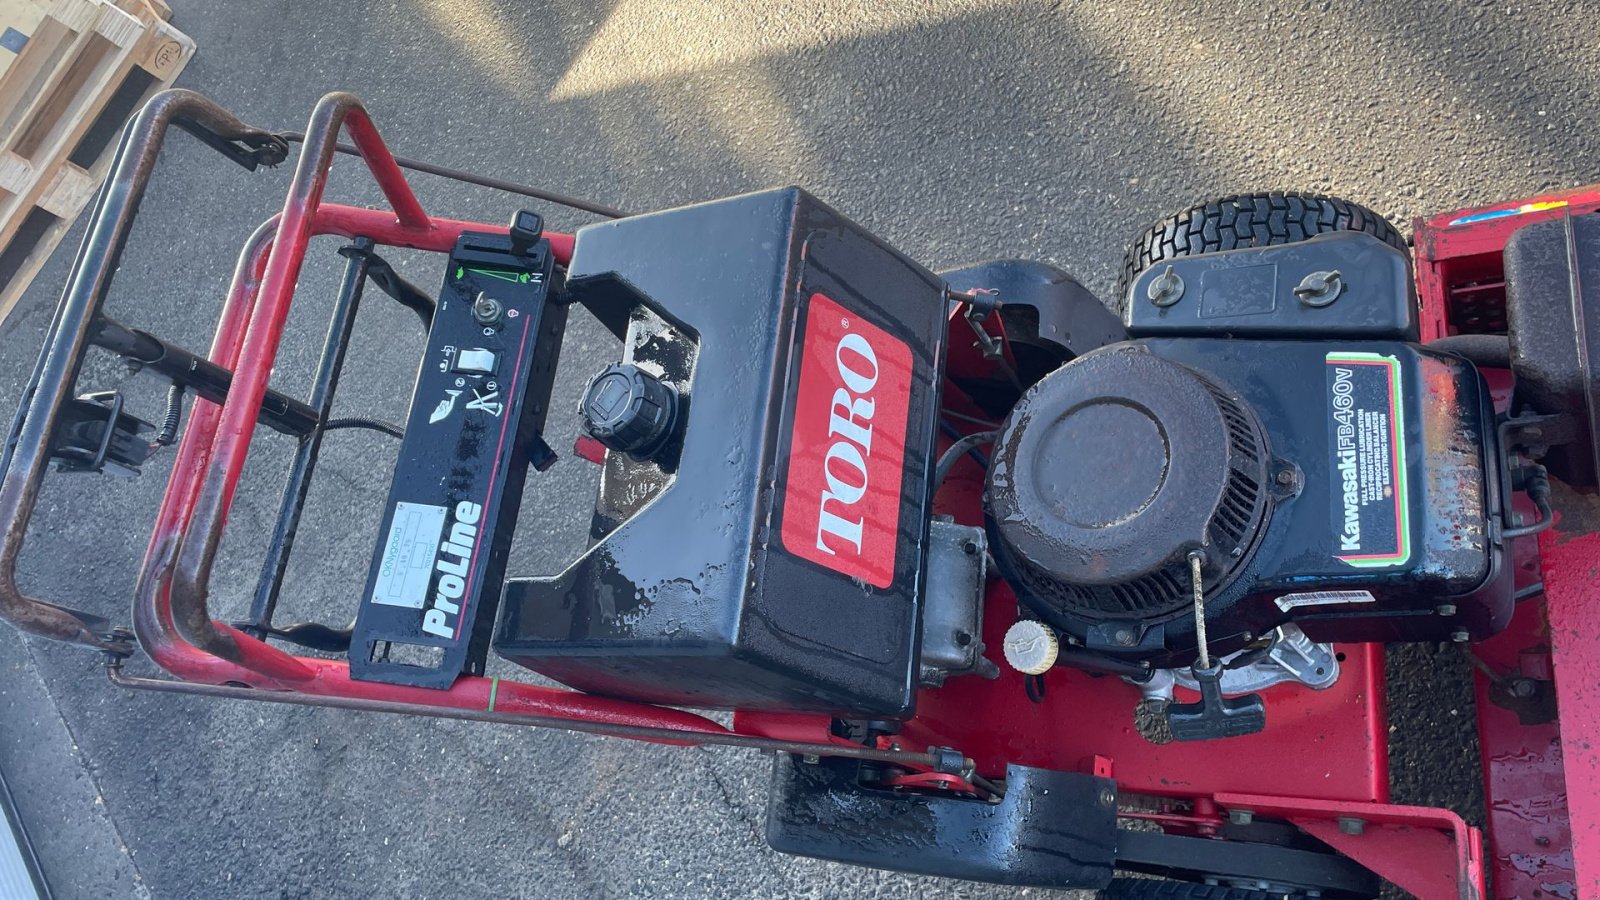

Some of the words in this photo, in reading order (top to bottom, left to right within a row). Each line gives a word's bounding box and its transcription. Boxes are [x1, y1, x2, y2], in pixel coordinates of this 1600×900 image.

[1357, 408, 1366, 451] LUBRICATION
[1364, 411, 1372, 431] LINER
[1371, 411, 1380, 447] BALANCER
[1379, 413, 1388, 442] IGNITION
[816, 333, 879, 556] TORO
[1365, 431, 1374, 464] CYLINDER
[1359, 451, 1368, 487] PRESSURE
[1373, 447, 1384, 501] RECIPROCATING
[1380, 442, 1390, 485] ELECTRONIC
[1361, 487, 1369, 506] FULL
[1367, 465, 1376, 501] CAST-IRON
[422, 500, 482, 639] ProLine
